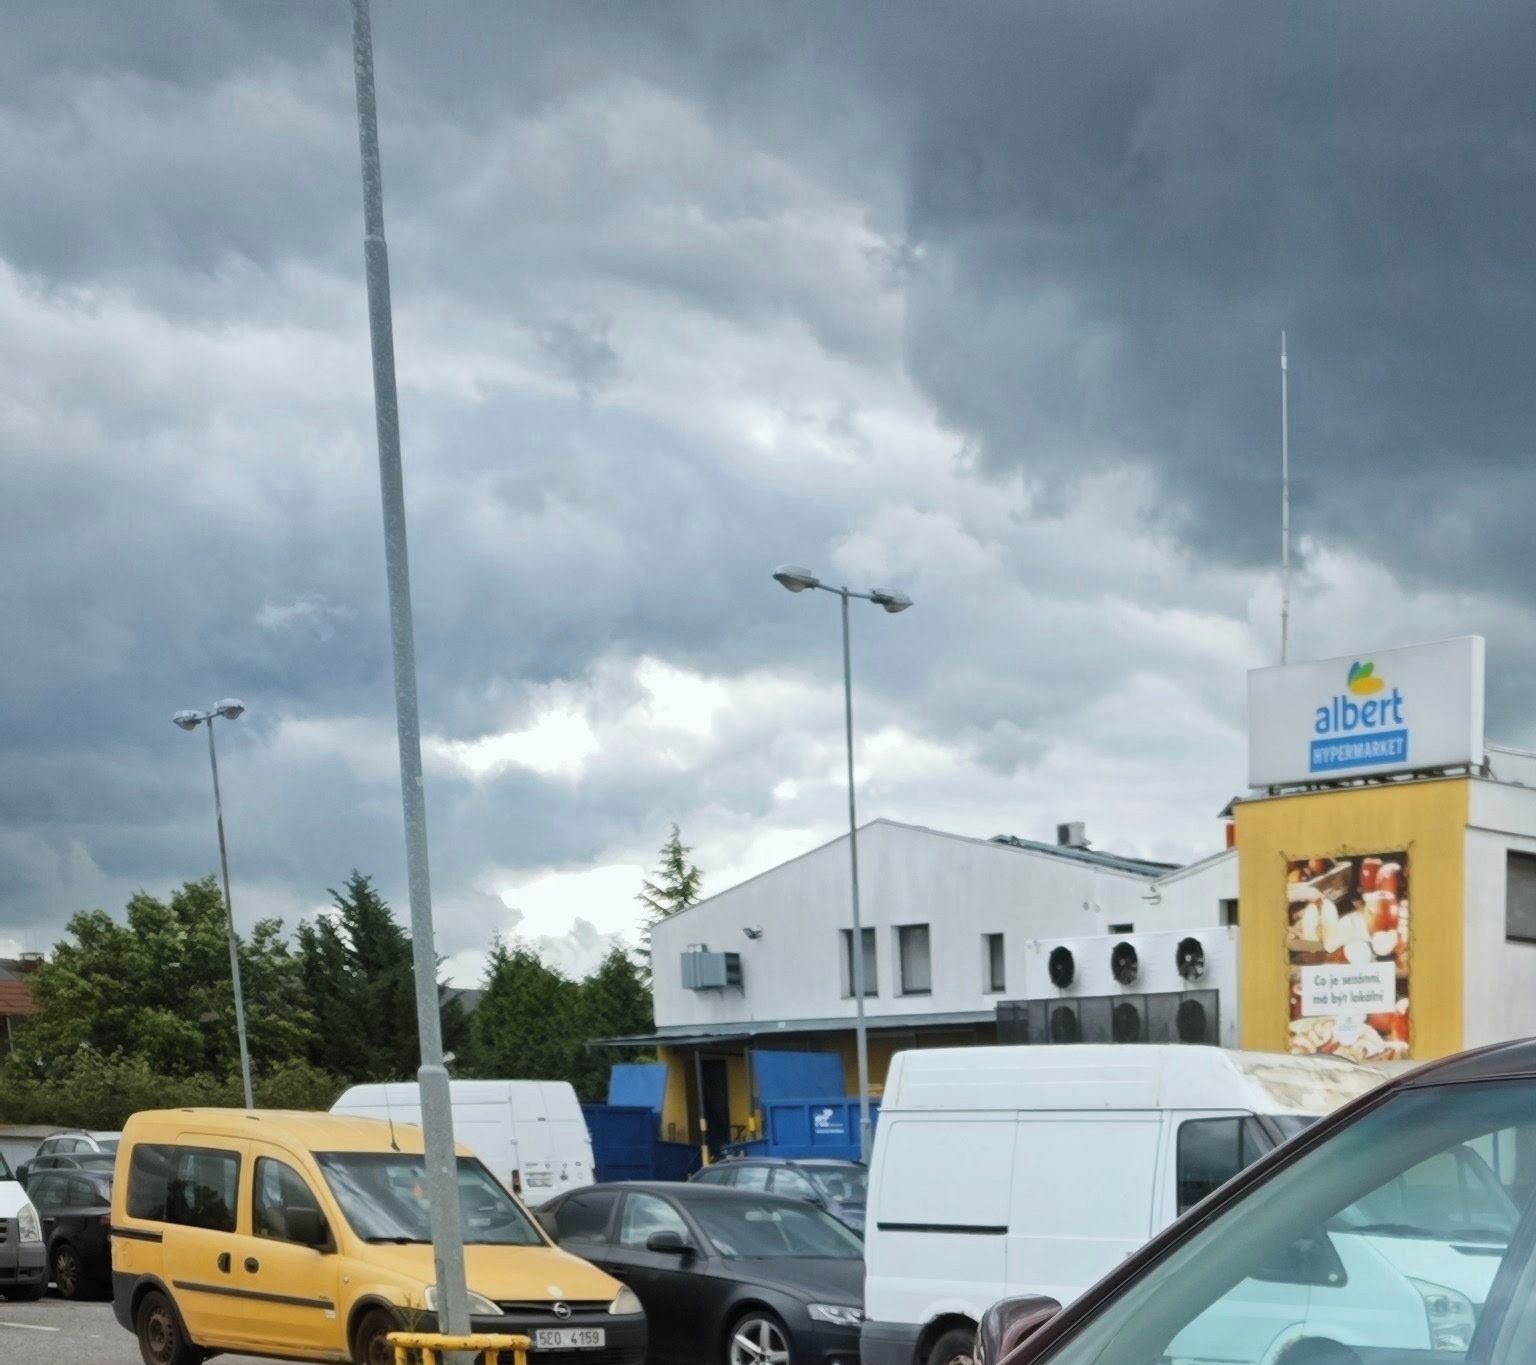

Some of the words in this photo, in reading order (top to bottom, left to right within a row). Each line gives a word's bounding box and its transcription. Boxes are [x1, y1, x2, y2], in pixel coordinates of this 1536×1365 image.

[1315, 688, 1404, 734] albert
[1312, 737, 1404, 765] HYPERMARKET
[570, 1331, 599, 1345] 4159
